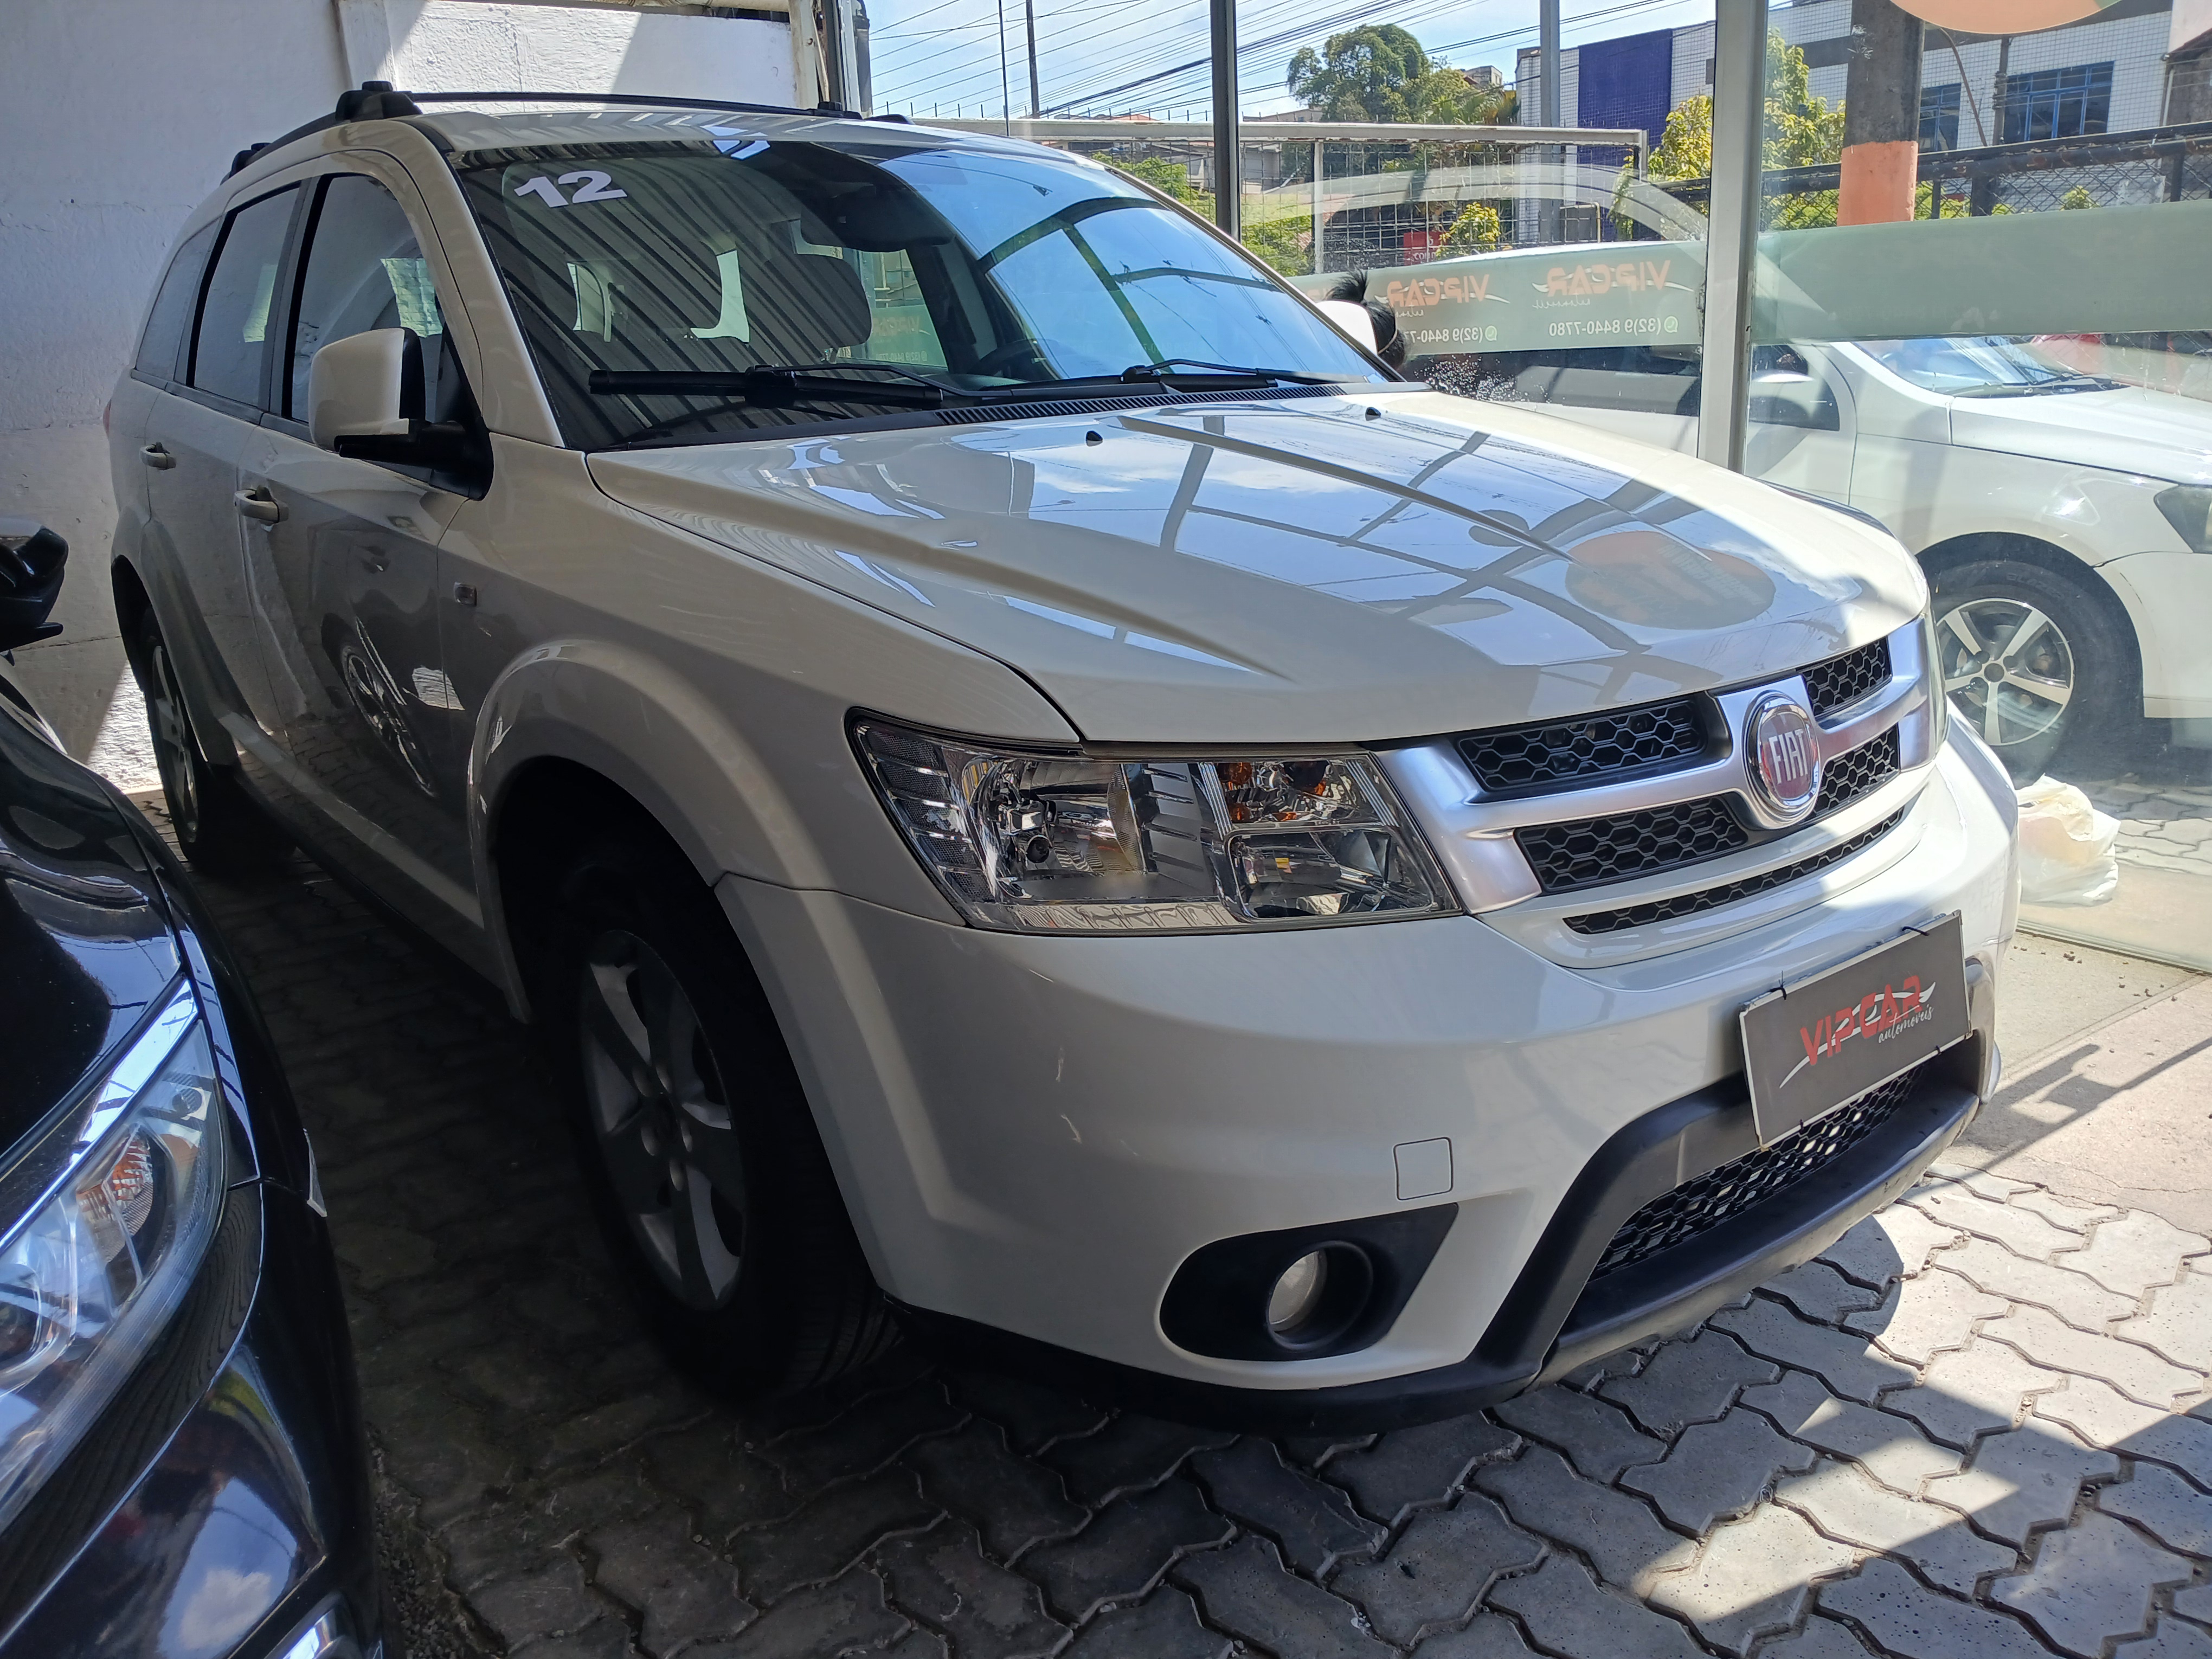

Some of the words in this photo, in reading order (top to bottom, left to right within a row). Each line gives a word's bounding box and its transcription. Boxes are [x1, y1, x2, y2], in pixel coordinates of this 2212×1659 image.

[514, 170, 628, 208] 12
[1769, 729, 1808, 785] FIAT
[1800, 975, 1923, 1065] VIPCAR
